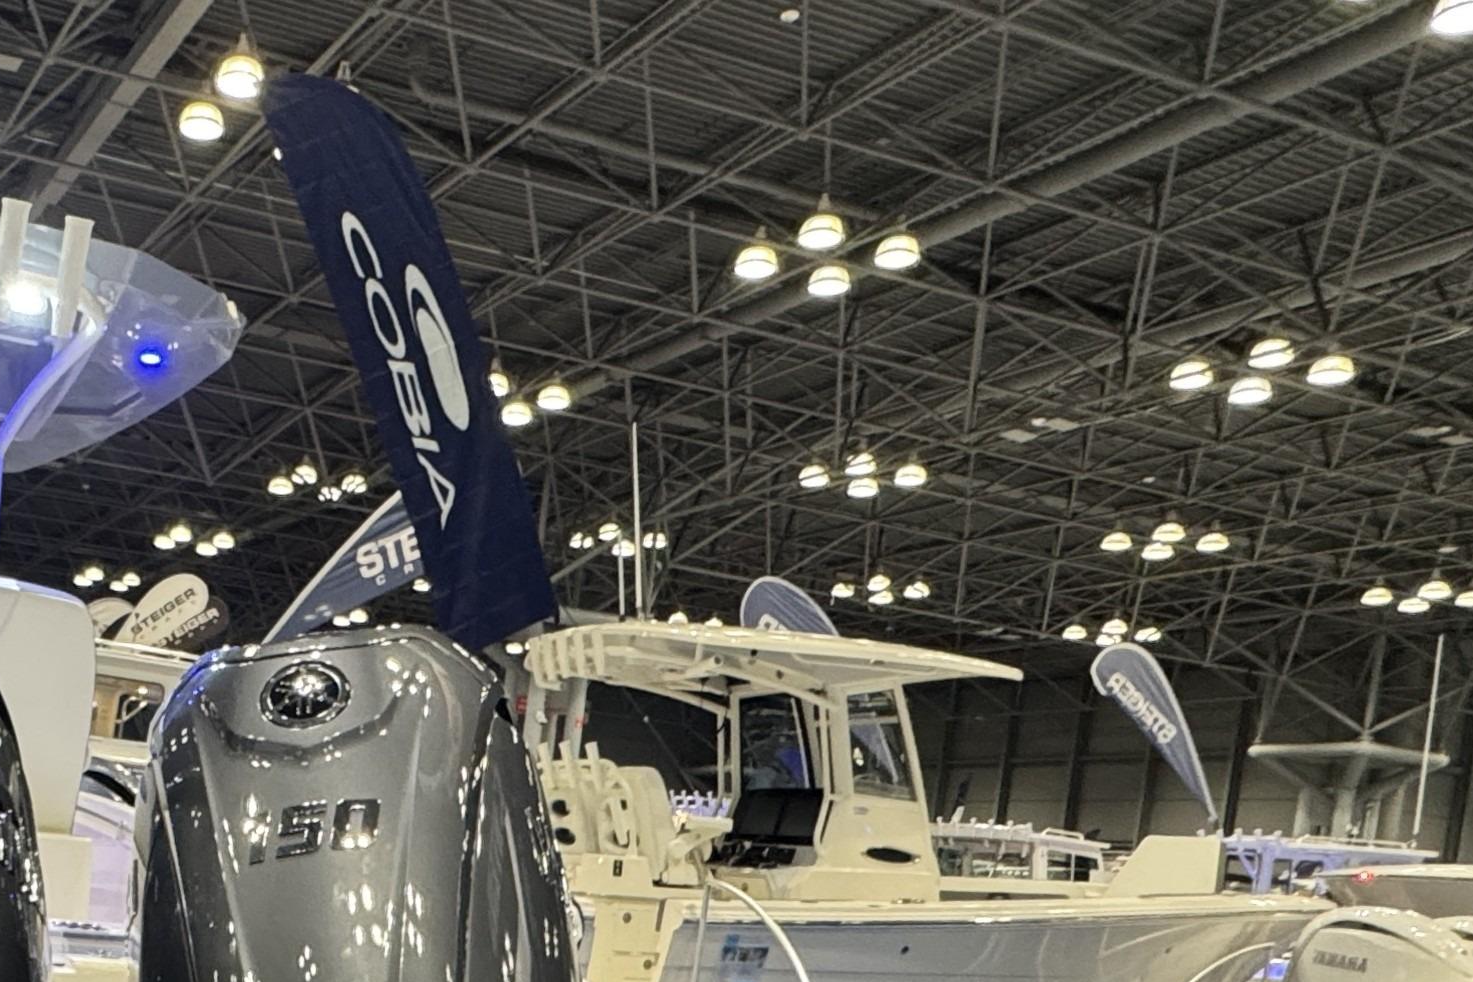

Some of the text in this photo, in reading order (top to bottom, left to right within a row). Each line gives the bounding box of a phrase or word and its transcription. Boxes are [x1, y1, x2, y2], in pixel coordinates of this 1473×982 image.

[340, 210, 457, 531] COBIA
[356, 525, 421, 578] STE
[130, 587, 196, 636] STEIGER
[242, 798, 383, 866] 150
